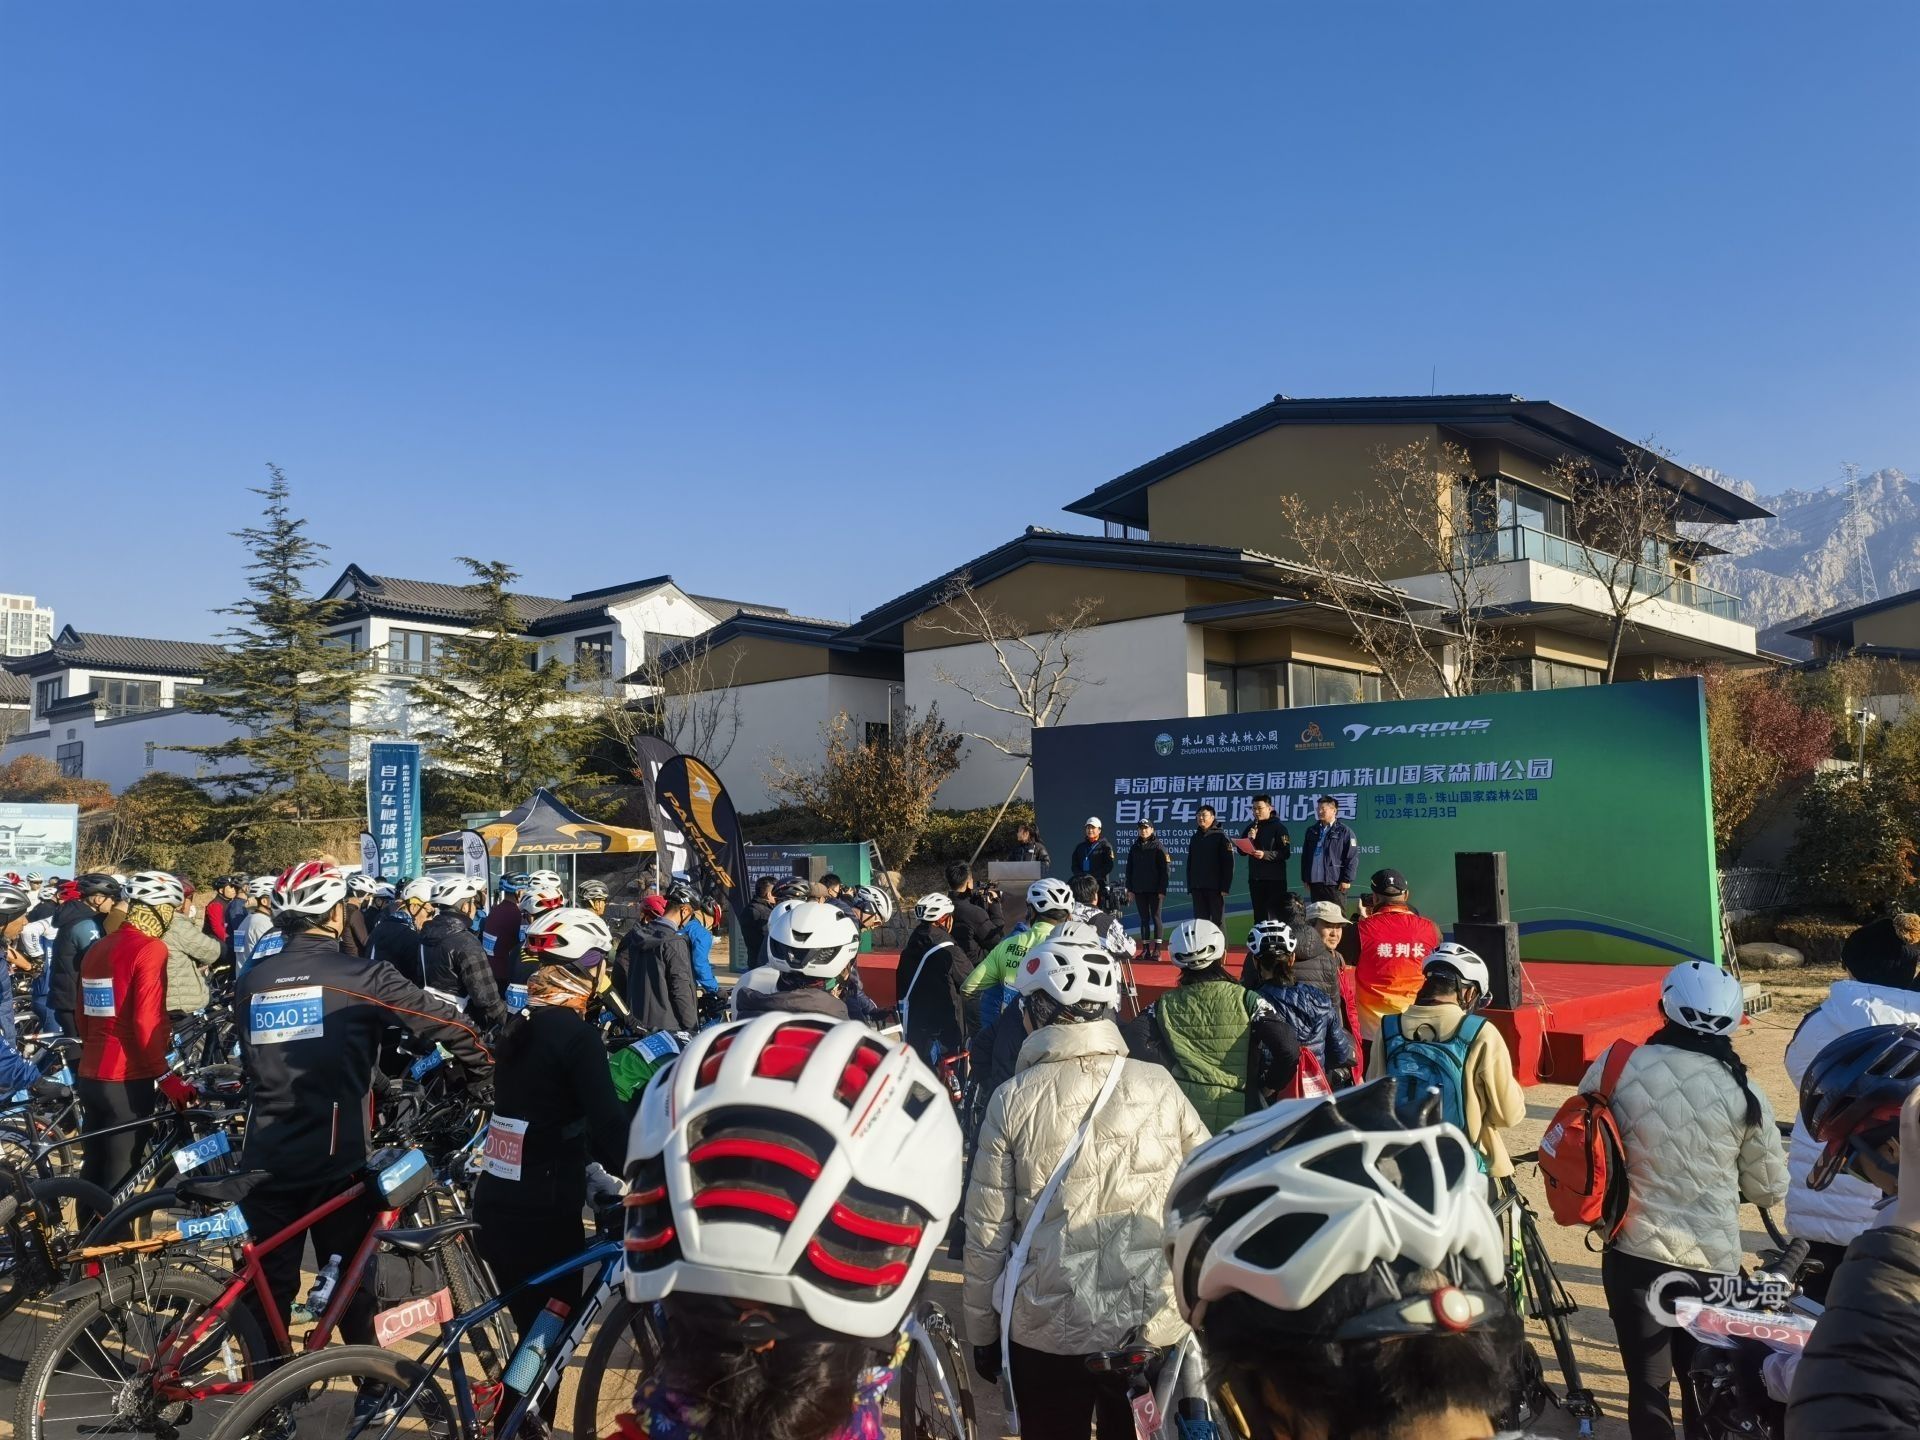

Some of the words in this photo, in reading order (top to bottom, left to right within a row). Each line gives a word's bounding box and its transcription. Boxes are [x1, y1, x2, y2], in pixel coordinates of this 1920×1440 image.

[1372, 719, 1493, 736] PARDUS
[1181, 730, 1278, 746] 珠山国家森林公园
[1208, 746, 1237, 754] NATIONAL
[1262, 743, 1278, 751] PARK
[1114, 758, 1553, 795] 青岛西海岸新区首届瑞豹杯珠山国家森林公园
[1375, 806, 1457, 819] 2023年12月3日
[664, 791, 737, 888] PARDUS
[1116, 829, 1139, 837] QINGD
[517, 842, 603, 852] PARDUS
[1377, 943, 1425, 958] 裁判长
[255, 1008, 299, 1029] B040
[1725, 1321, 1805, 1347] C021
